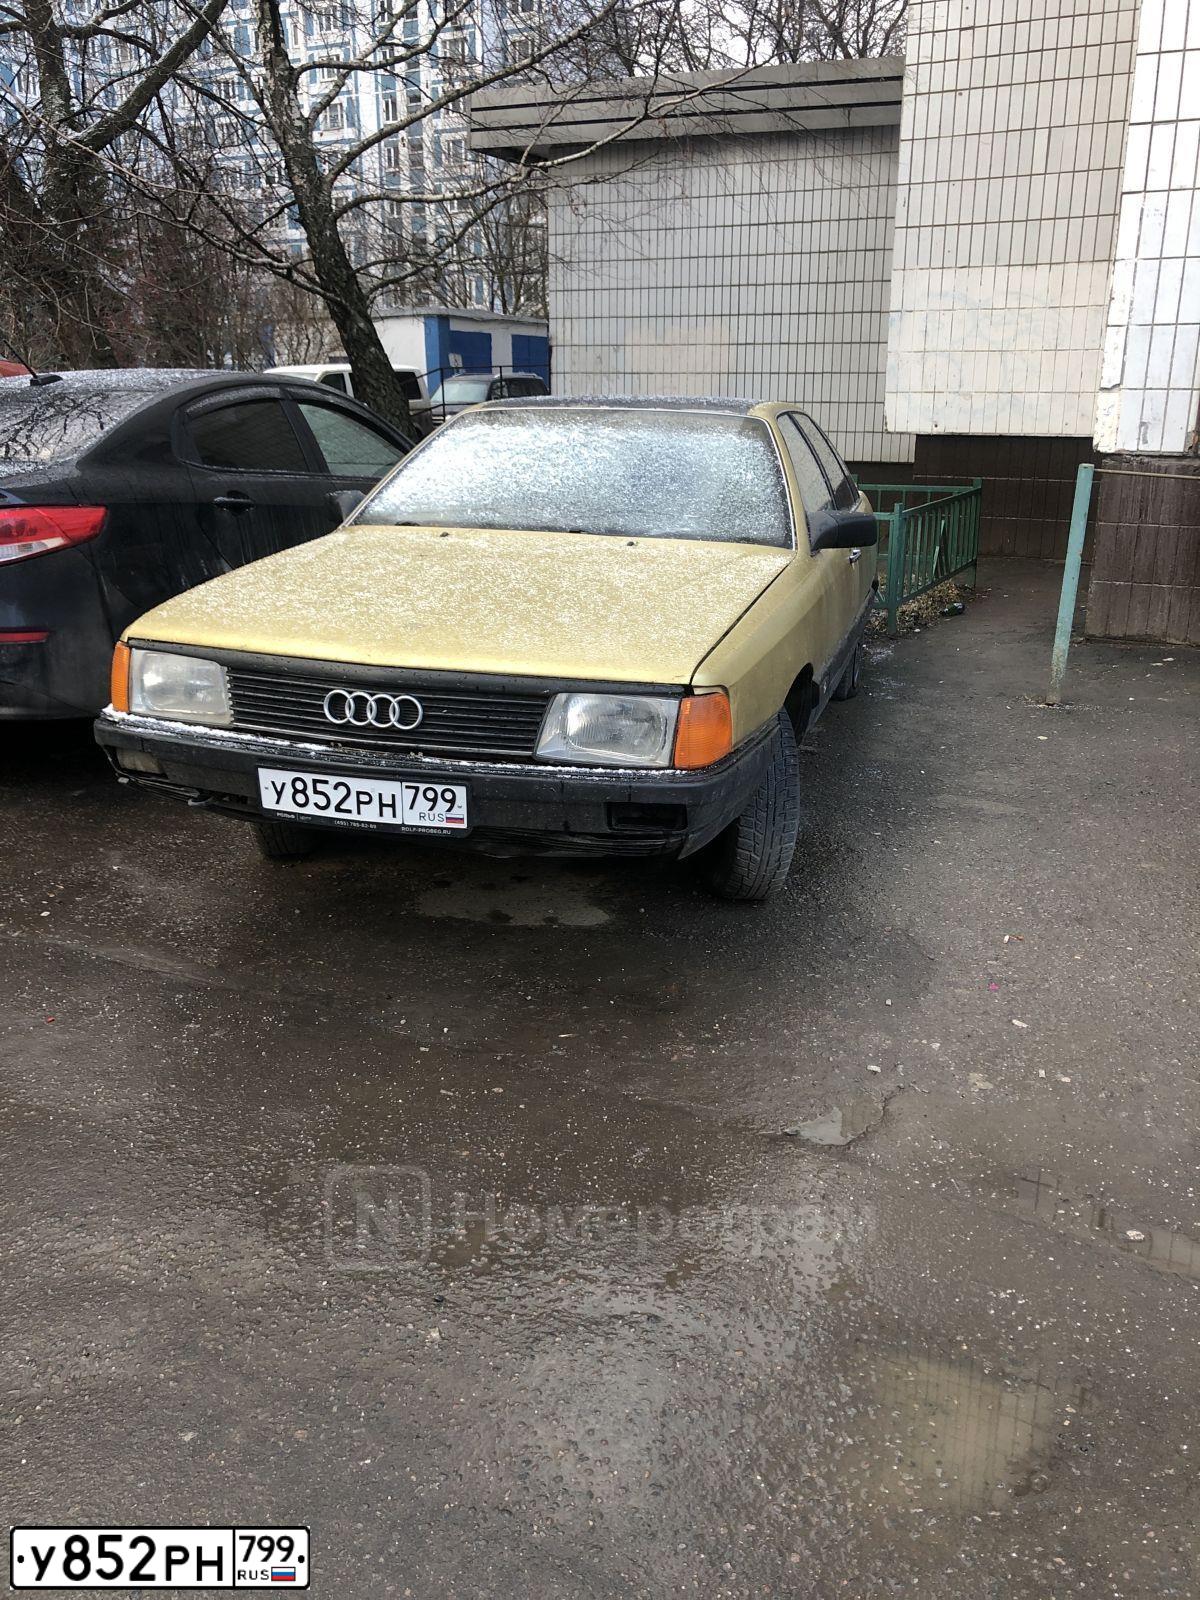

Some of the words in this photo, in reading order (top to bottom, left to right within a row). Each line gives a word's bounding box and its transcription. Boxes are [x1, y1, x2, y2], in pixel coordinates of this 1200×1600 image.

[270, 777, 397, 819] У852РН
[404, 785, 457, 812] 799
[419, 812, 445, 822] RUS
